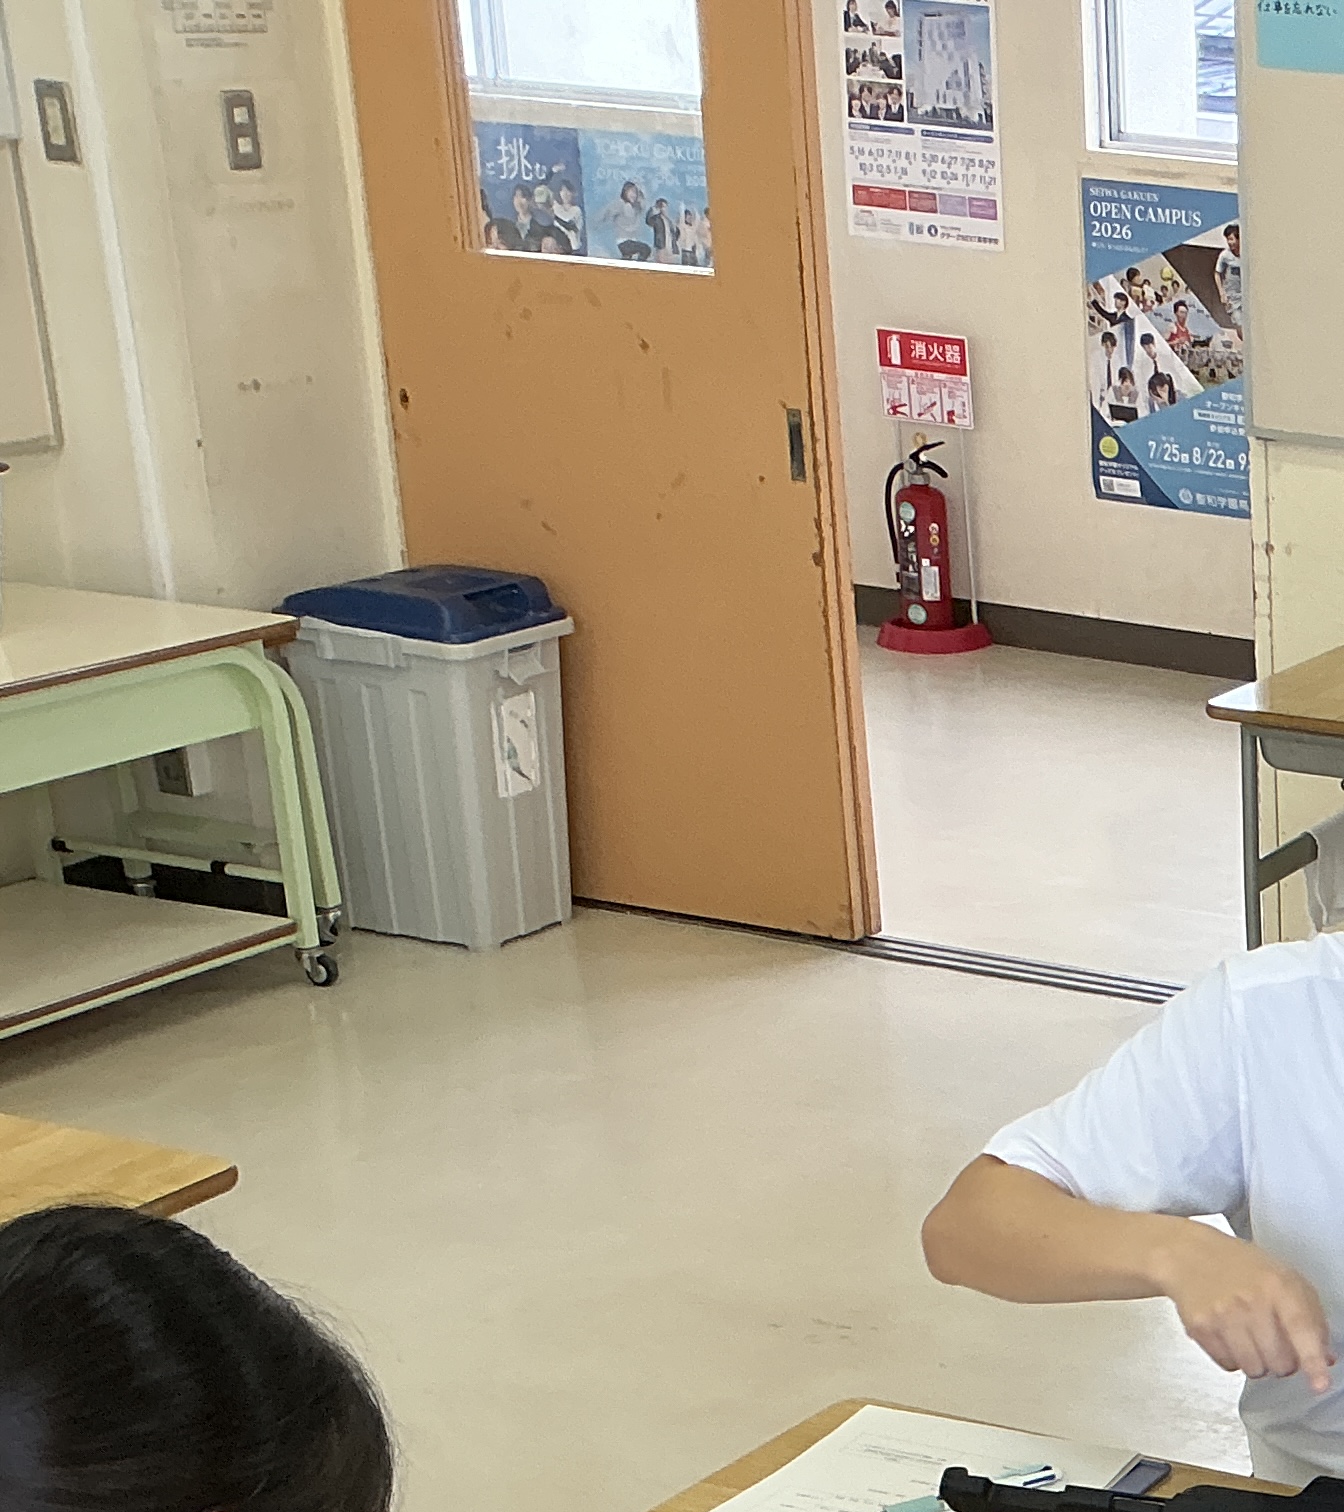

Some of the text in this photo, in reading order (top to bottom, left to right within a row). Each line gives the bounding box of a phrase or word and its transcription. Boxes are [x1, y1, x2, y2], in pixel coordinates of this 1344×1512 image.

[1089, 186, 1119, 200] SEIWA
[1089, 200, 1202, 228] OPEN CAMPUS
[1091, 221, 1132, 240] 2026
[910, 339, 961, 365] 消火器
[1148, 440, 1180, 463] 7/25
[1193, 447, 1226, 469] 8/22
